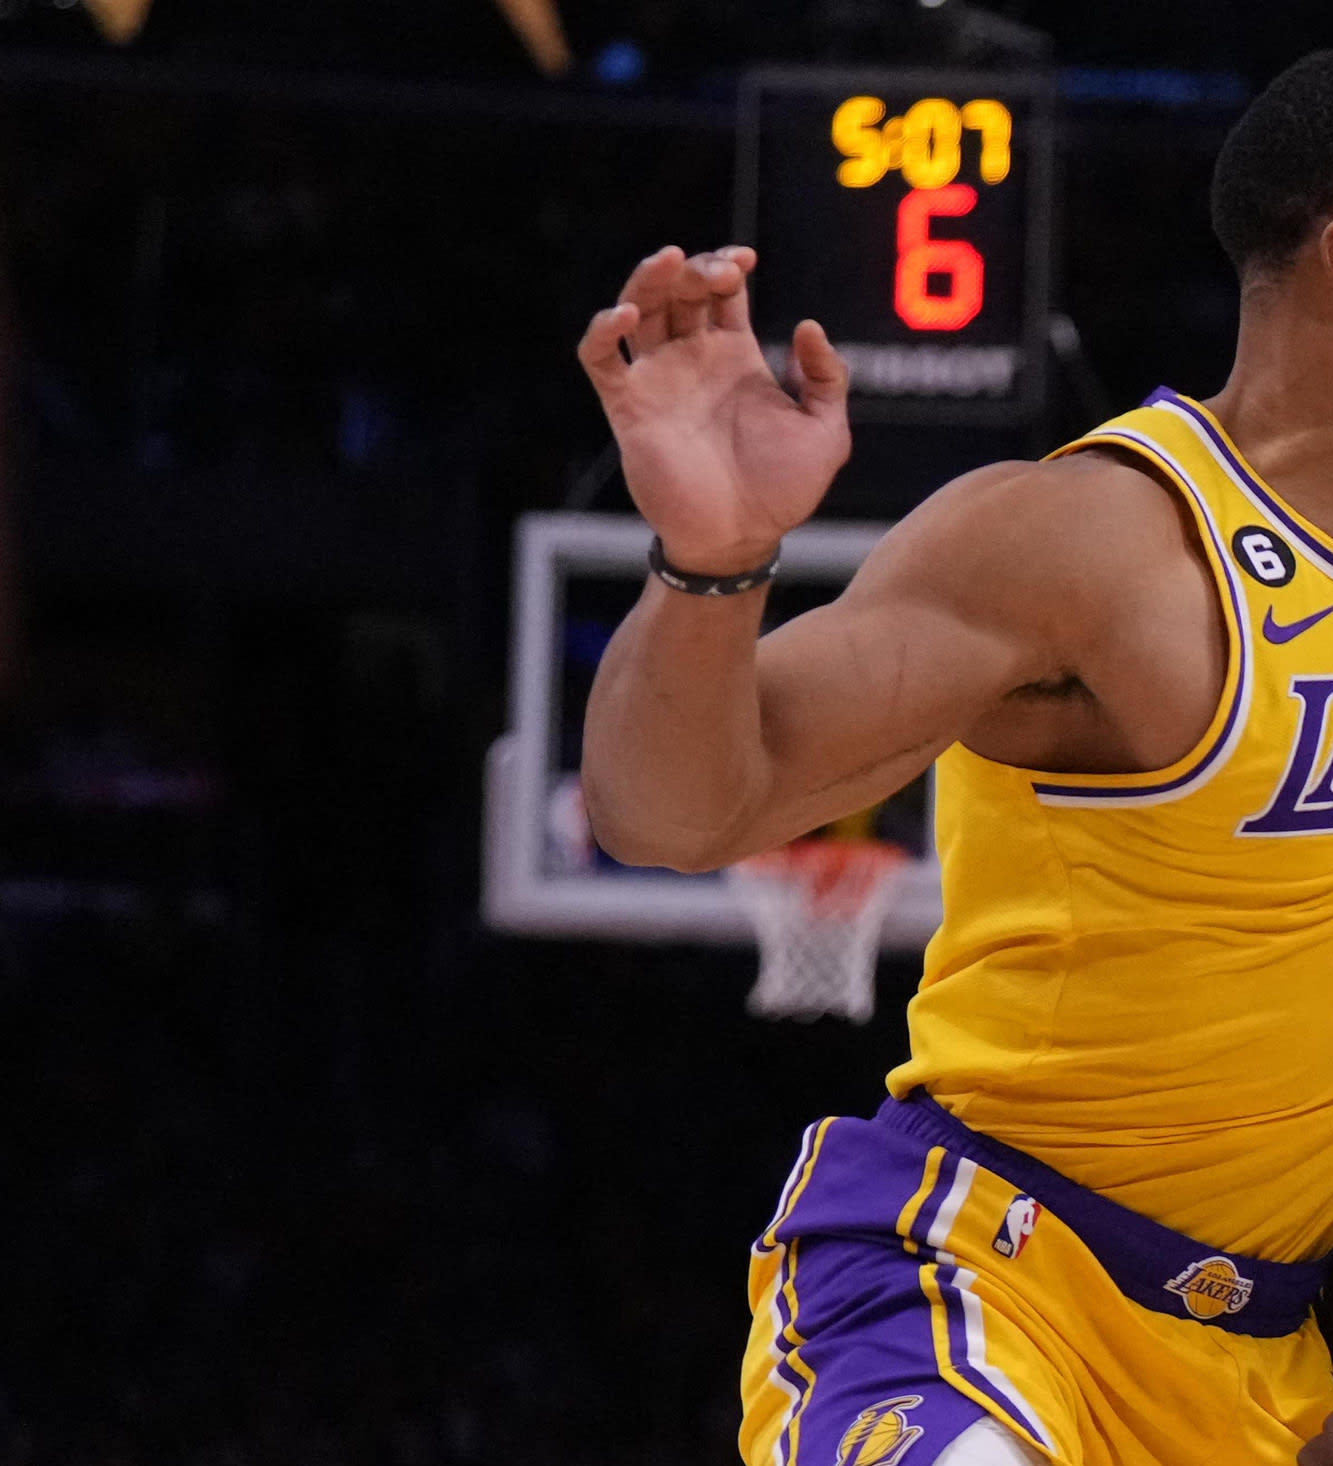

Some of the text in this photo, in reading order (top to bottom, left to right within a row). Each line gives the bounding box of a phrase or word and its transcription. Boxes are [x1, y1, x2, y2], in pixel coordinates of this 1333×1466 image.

[832, 96, 1012, 188] 5:07
[894, 183, 985, 331] 6
[1242, 533, 1286, 581] 6
[1168, 1266, 1250, 1311] LAKERS
